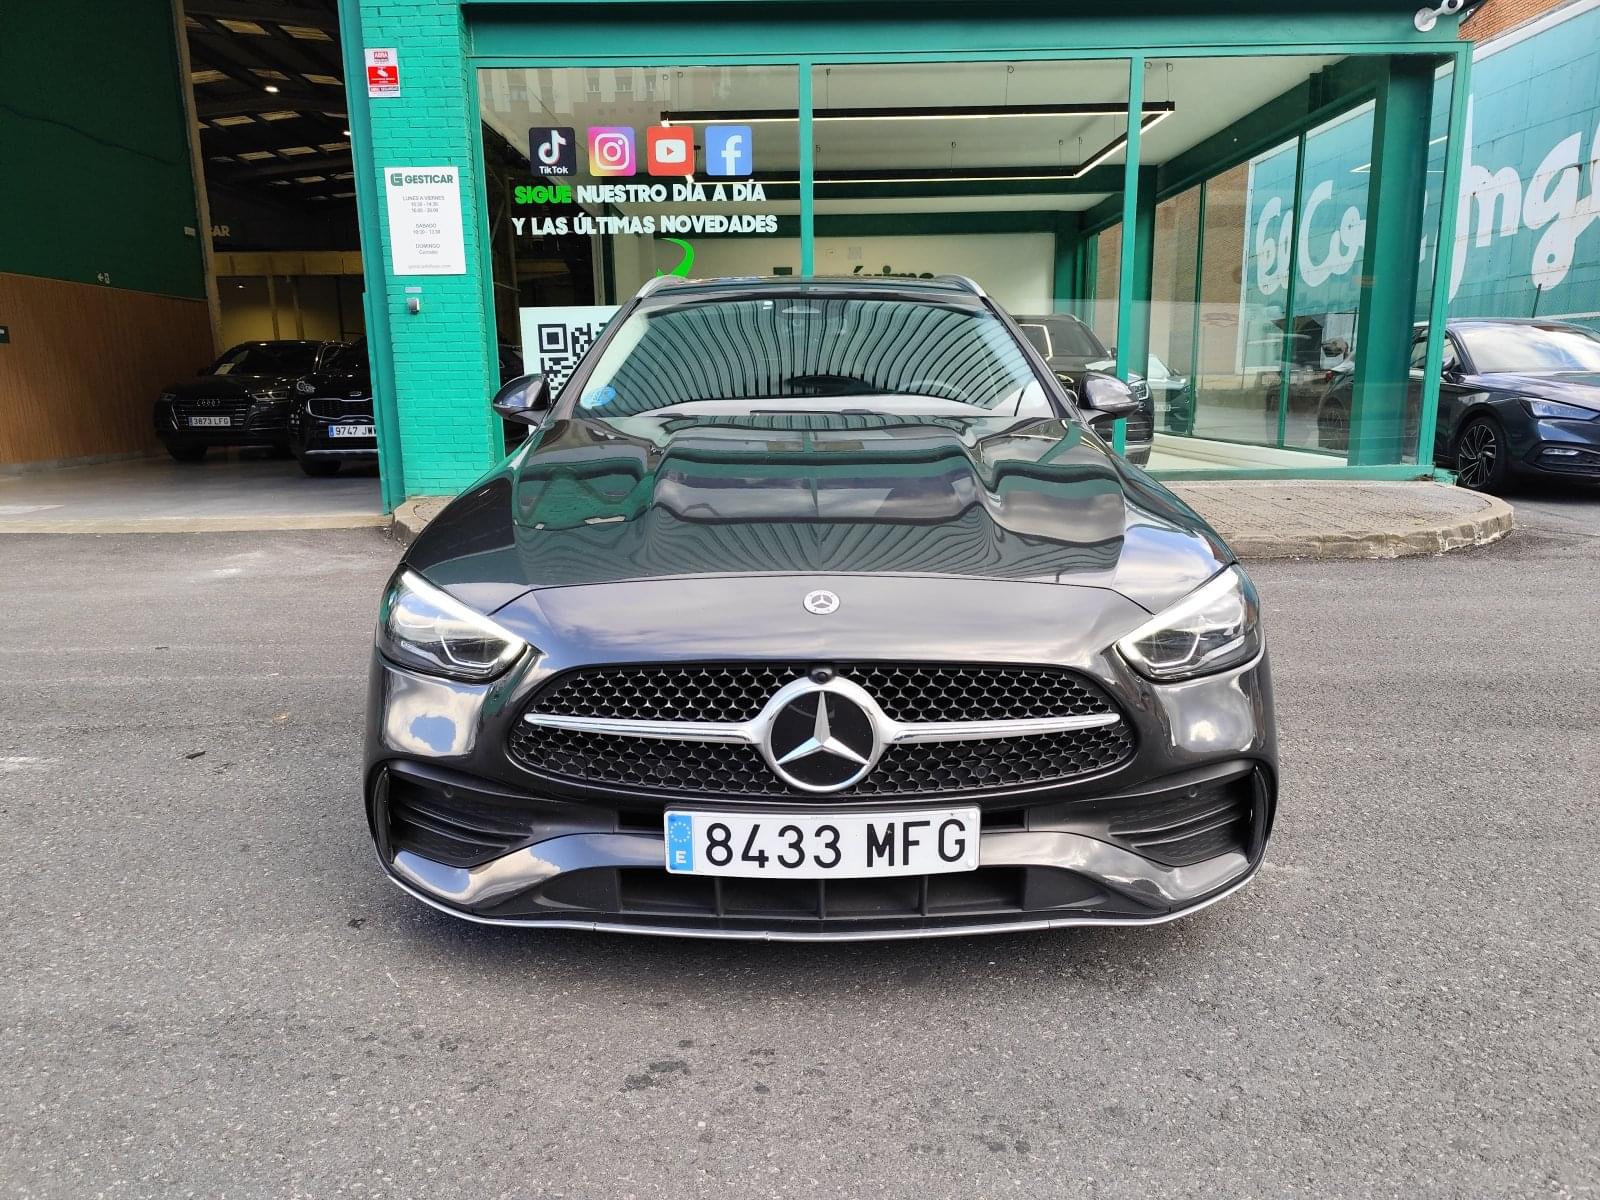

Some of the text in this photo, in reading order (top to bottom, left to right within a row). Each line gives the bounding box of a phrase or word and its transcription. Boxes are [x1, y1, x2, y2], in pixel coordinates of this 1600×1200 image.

[404, 174, 454, 184] GESTICAR
[539, 165, 569, 174] TikTok
[514, 179, 767, 204] SIGUE NUESTRO DÍA A DÍA
[511, 212, 778, 236] Y LAS ÚLTIMAS NOVEDADES
[705, 818, 967, 869] 8433 MFG
[675, 850, 687, 864] E
